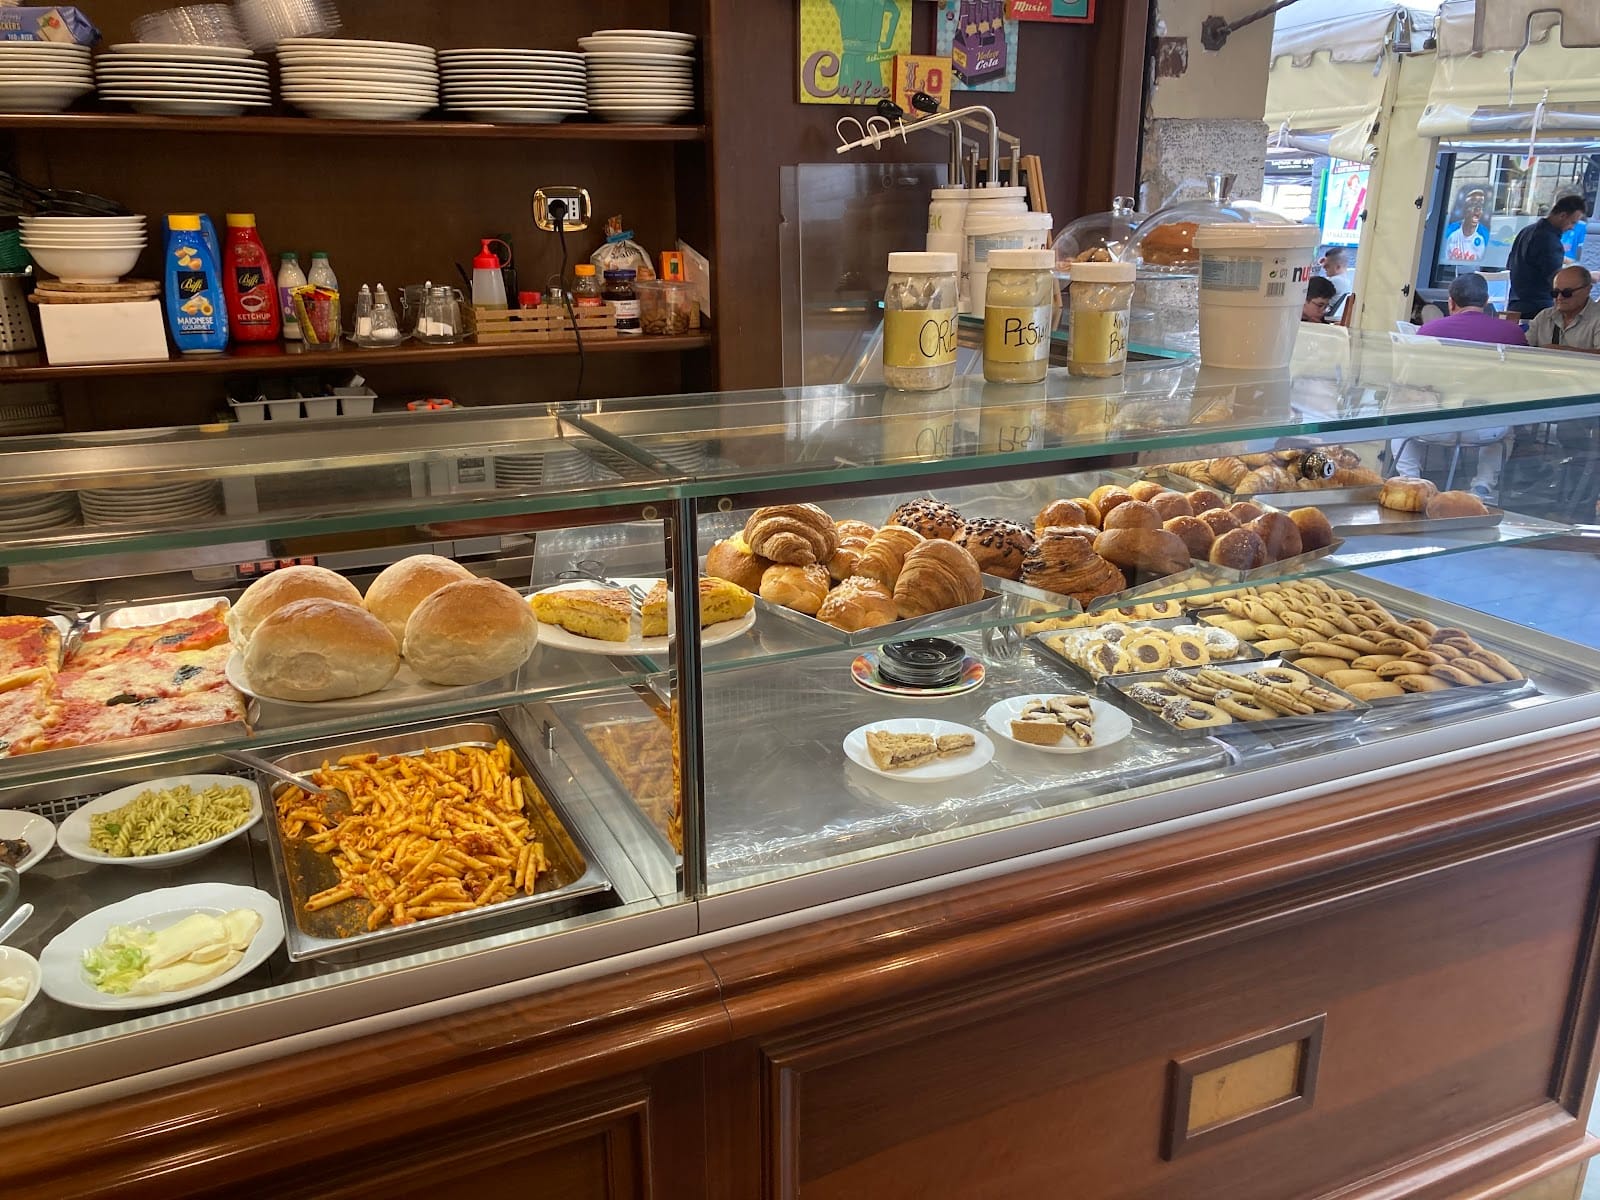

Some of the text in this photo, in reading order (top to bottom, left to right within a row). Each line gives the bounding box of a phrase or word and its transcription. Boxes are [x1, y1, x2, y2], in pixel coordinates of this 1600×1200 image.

[1014, 1, 1047, 12] Music
[976, 58, 999, 70] Cola
[802, 50, 891, 104] Coffee
[177, 316, 214, 325] MAIONESE
[238, 313, 271, 321] KETCHUP
